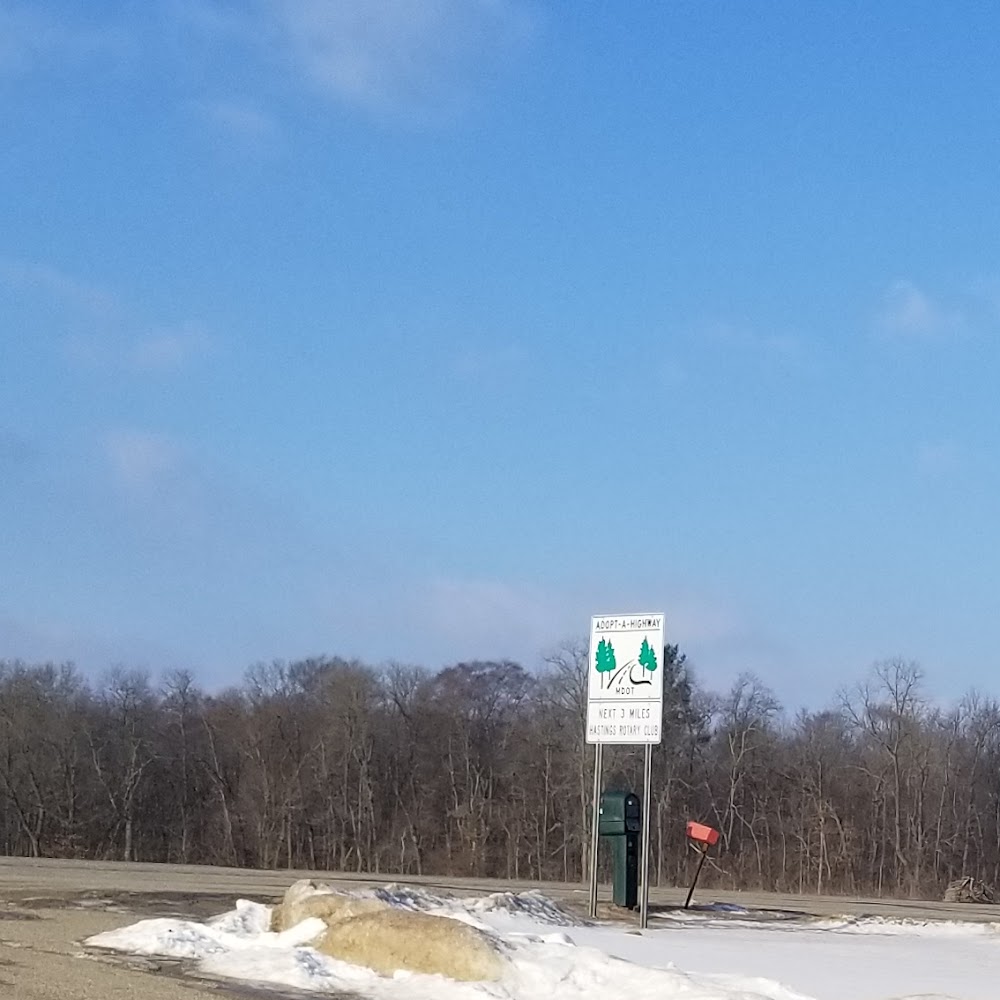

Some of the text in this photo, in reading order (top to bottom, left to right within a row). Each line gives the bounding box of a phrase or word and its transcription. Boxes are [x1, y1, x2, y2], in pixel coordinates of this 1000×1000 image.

[596, 618, 661, 629] ADOPT-A-HIGHWAY
[616, 687, 635, 695] MDOT
[599, 709, 616, 719] NEXT
[629, 708, 650, 719] MILES
[589, 725, 659, 736] HASTINGS ROTARY CLUB
